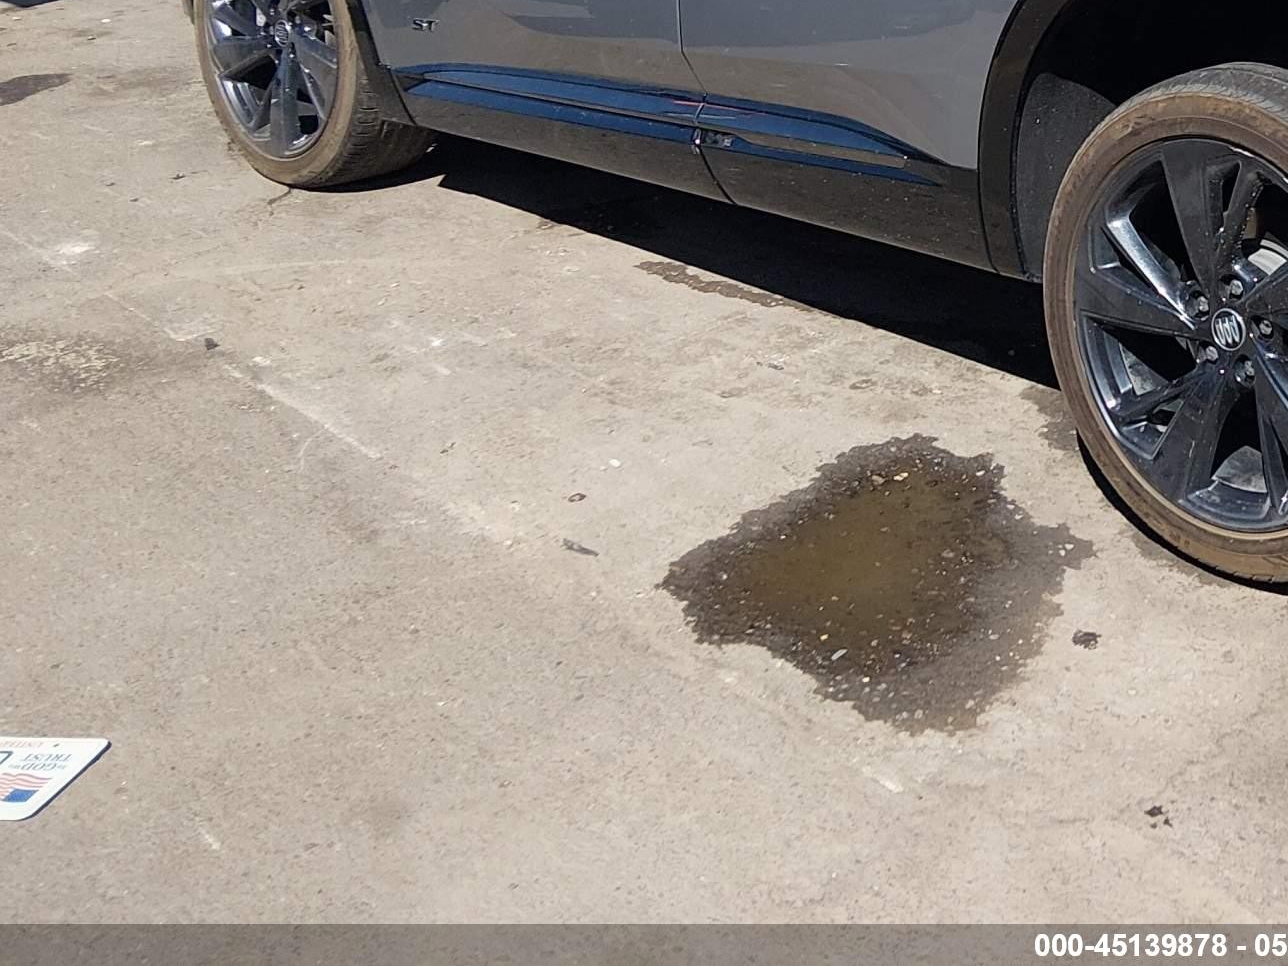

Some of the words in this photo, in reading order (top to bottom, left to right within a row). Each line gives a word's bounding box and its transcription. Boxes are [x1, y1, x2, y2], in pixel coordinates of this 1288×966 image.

[411, 17, 440, 33] ST
[20, 753, 72, 762] TRUST
[21, 762, 57, 771] GOD
